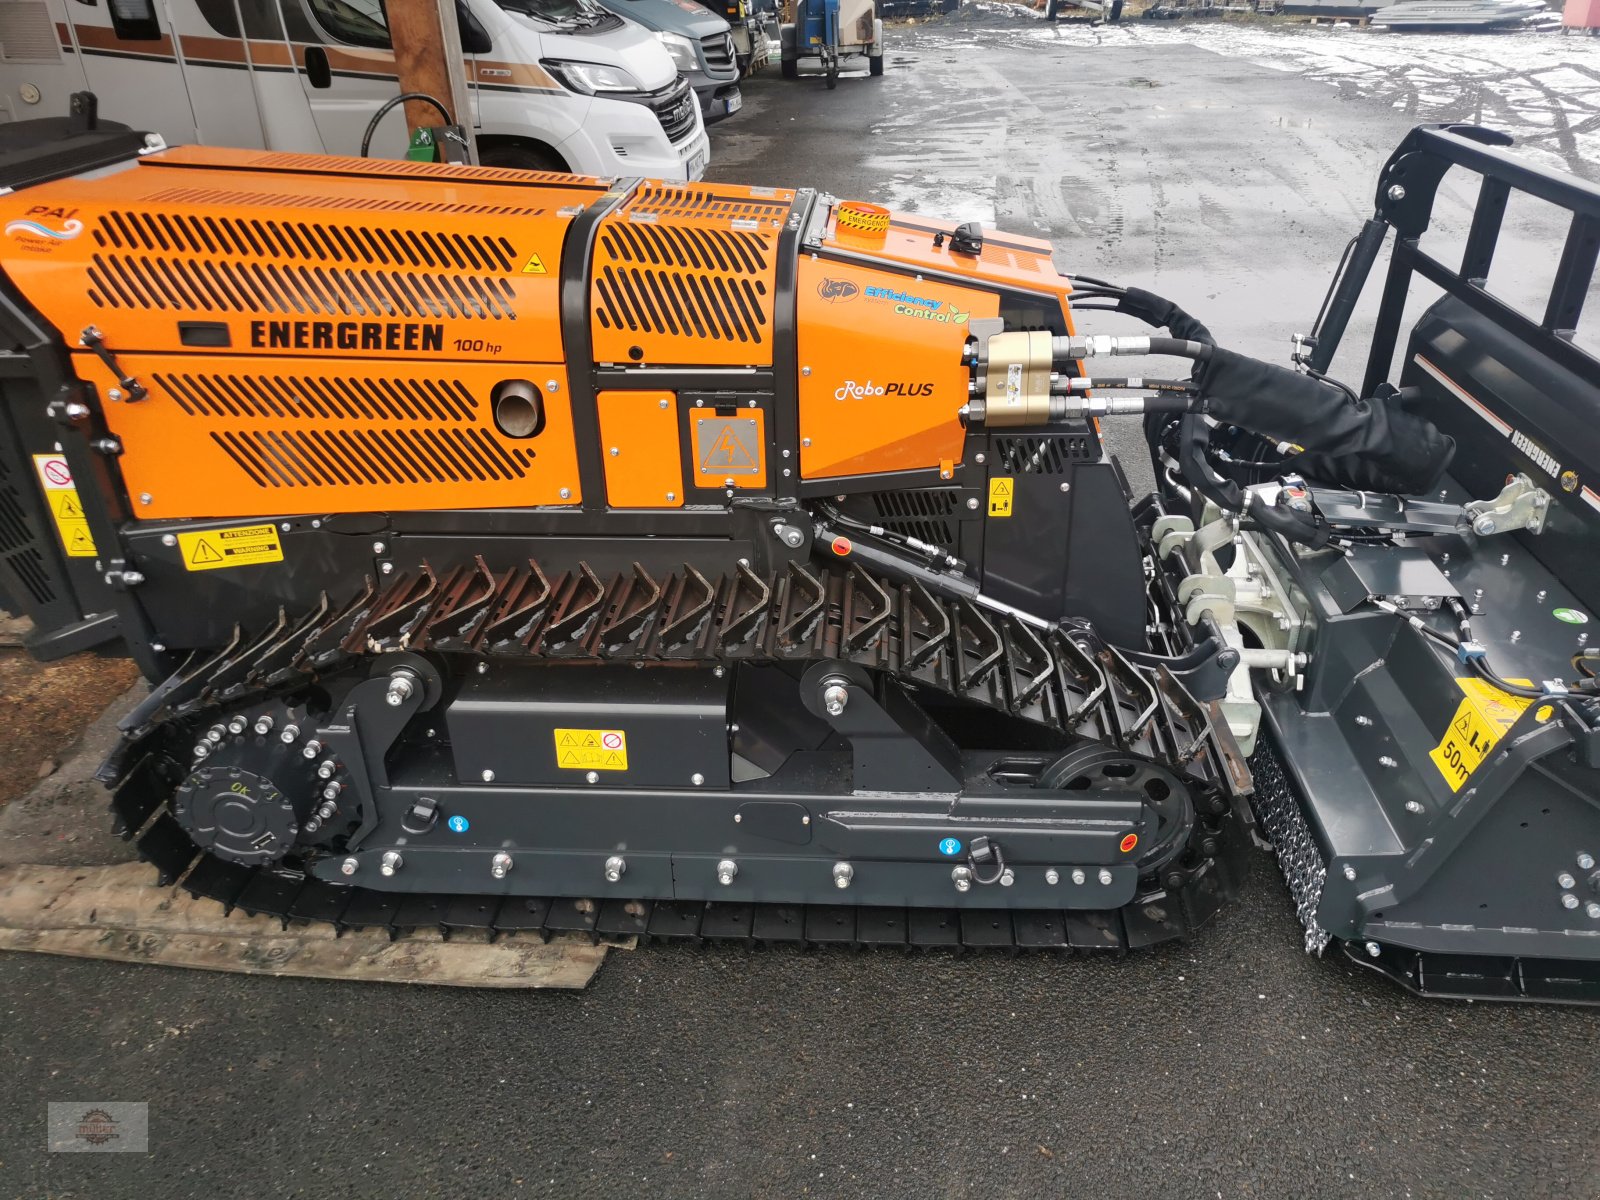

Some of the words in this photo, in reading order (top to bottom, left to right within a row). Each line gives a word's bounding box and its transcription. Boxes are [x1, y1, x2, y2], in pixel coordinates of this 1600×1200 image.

[24, 206, 79, 219] PAI
[864, 286, 943, 310] Efficiency
[893, 303, 951, 324] Control
[250, 320, 444, 352] ENERGREEN
[453, 338, 484, 352] 100
[486, 341, 502, 355] hp
[1511, 429, 1561, 479] ENERGREEN
[222, 528, 270, 539] ATTENZIONE
[232, 545, 270, 554] WARNING
[1443, 740, 1471, 781] 50m
